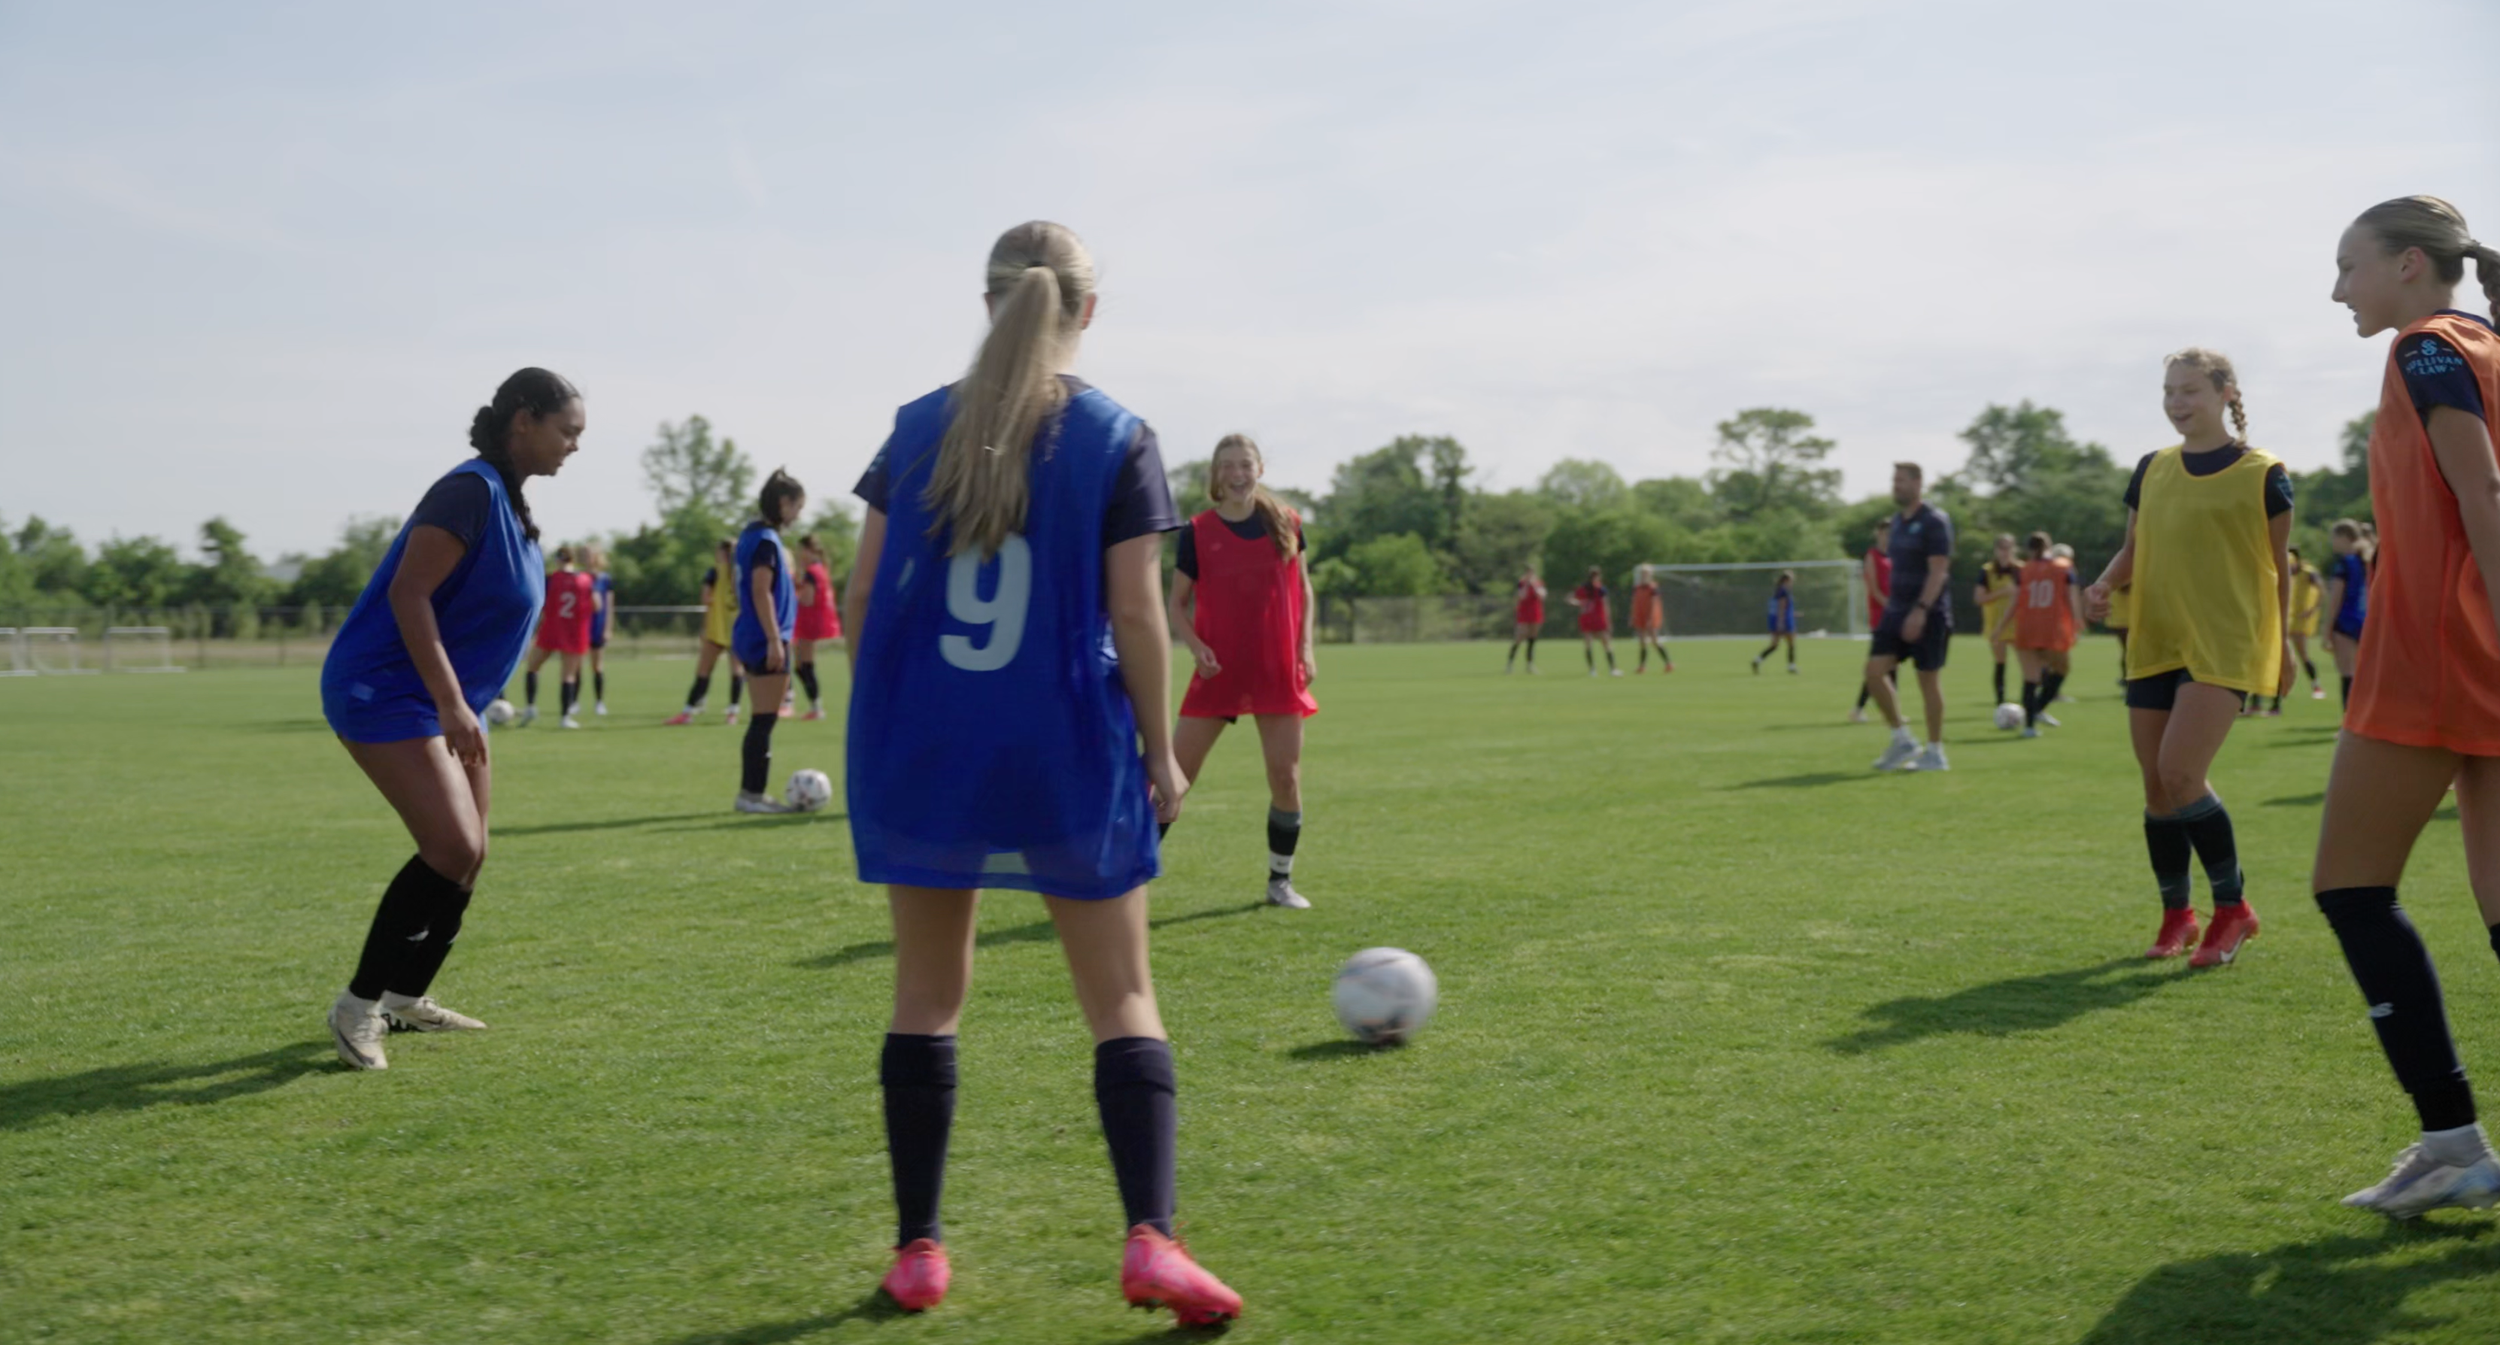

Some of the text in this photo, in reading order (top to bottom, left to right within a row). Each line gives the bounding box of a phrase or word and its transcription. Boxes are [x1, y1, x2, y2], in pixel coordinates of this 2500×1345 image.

[2419, 364, 2448, 375] LAW
[559, 592, 577, 618] 2
[938, 530, 1033, 672] 9
[2028, 578, 2055, 608] 10
